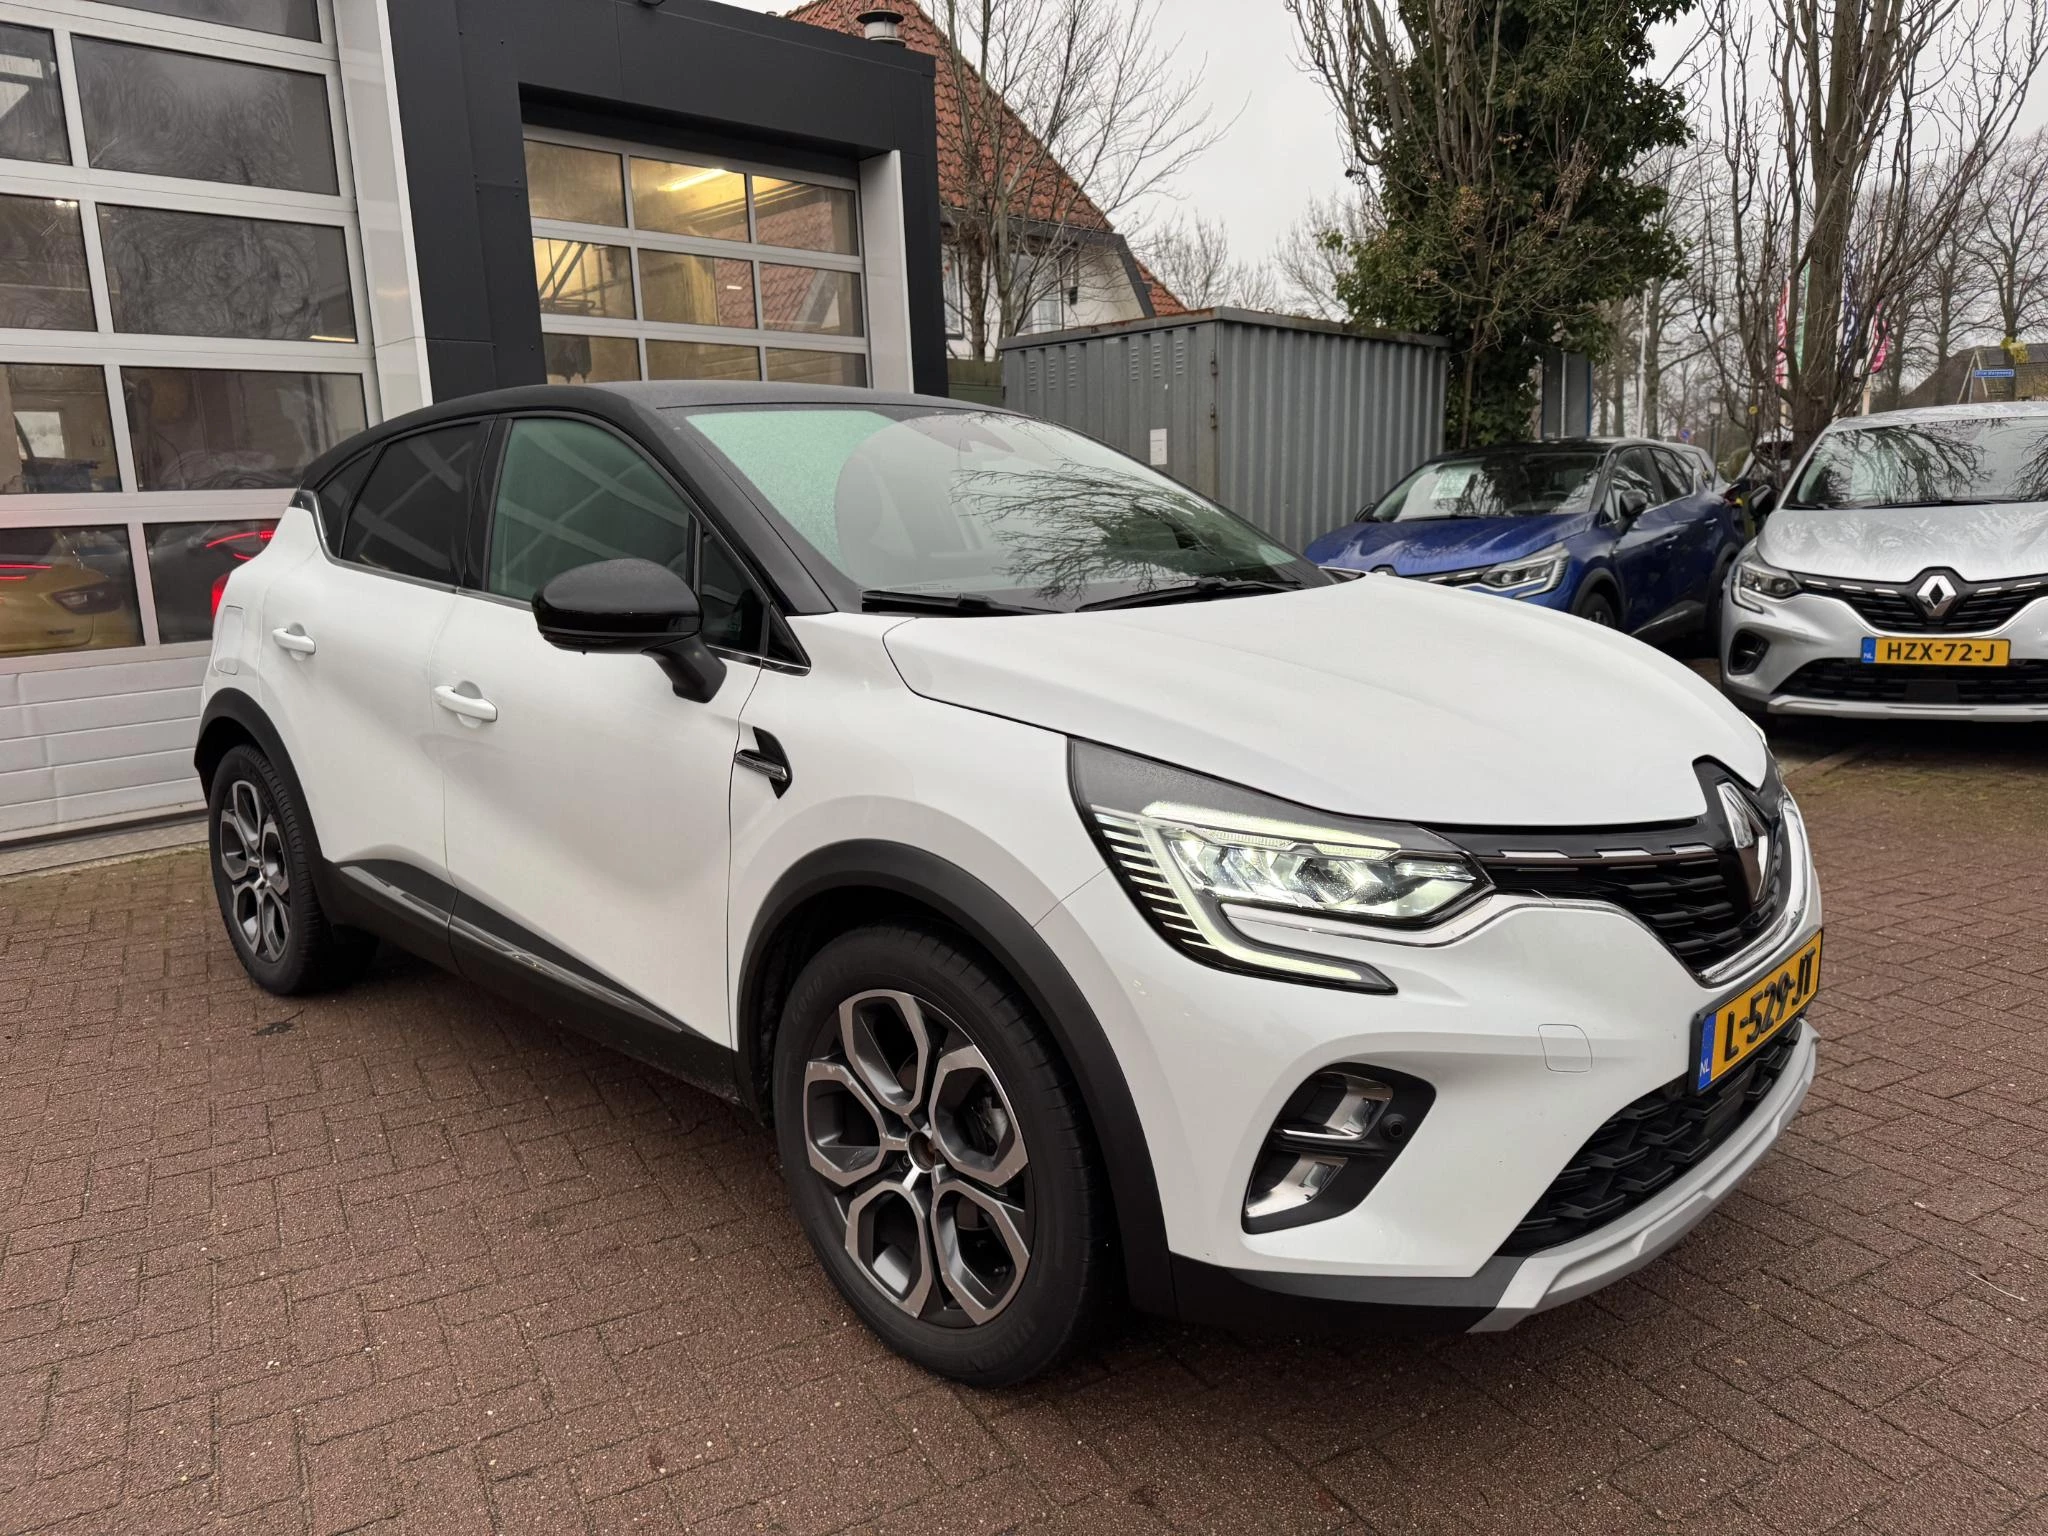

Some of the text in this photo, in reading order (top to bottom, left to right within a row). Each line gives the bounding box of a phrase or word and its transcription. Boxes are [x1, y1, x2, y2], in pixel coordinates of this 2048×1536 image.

[1887, 642, 1995, 662] HZX-72-J
[1724, 947, 1816, 1062] L-529-JT
[1699, 1058, 1711, 1077] NL
